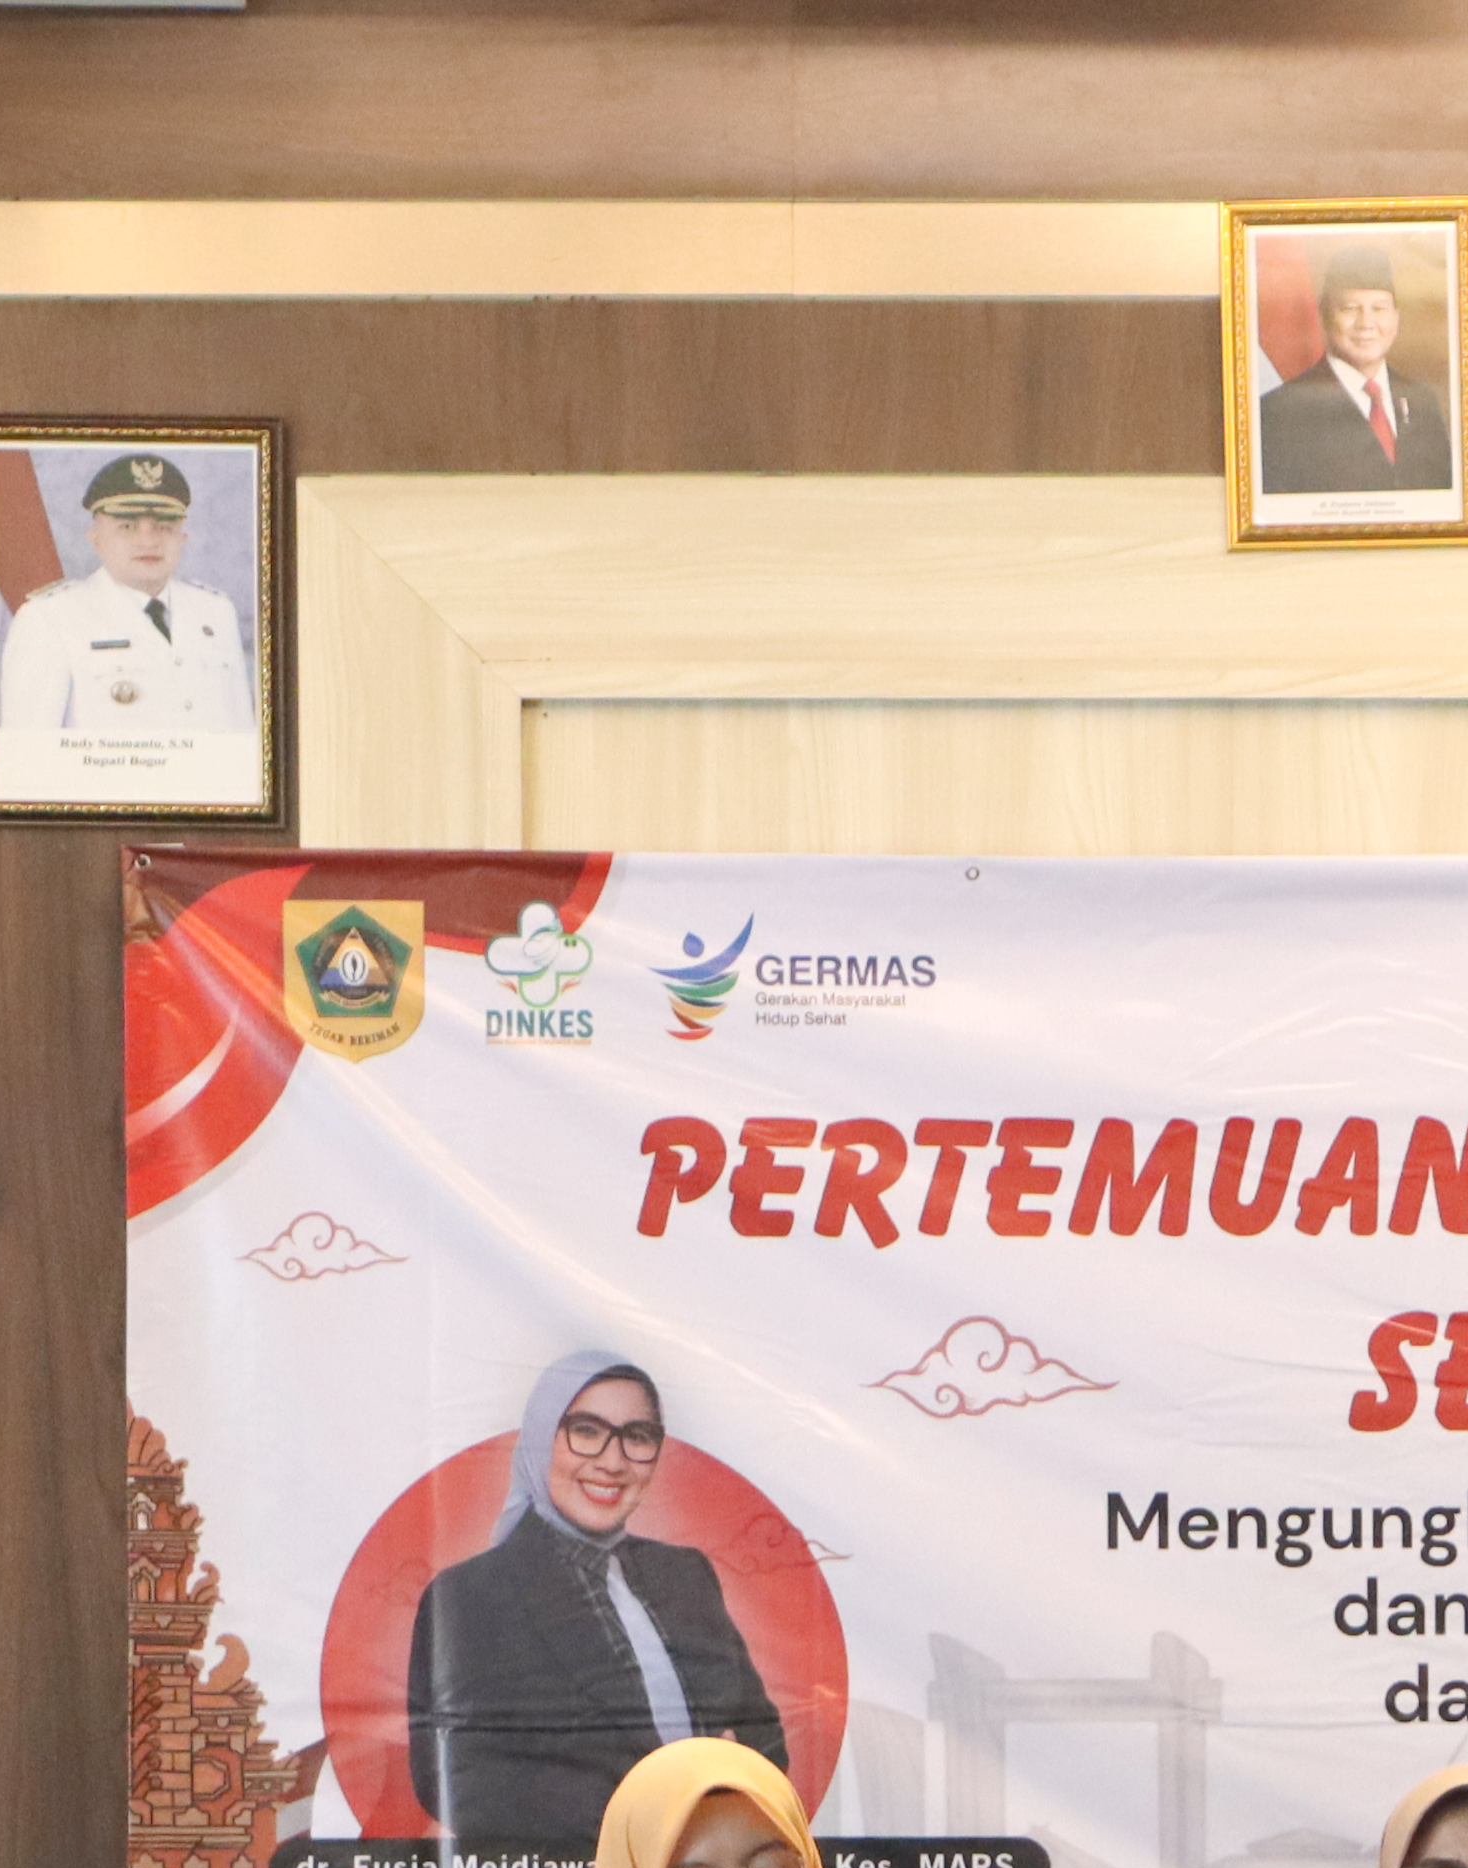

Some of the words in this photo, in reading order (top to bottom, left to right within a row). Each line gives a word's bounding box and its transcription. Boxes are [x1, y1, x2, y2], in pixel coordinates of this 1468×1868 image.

[755, 954, 937, 987] GERMAS
[755, 992, 817, 1006] Gerakan
[823, 993, 906, 1008] Masyarakat
[486, 1009, 594, 1038] DINKES
[755, 1012, 800, 1027] Hidup
[804, 1011, 848, 1026] Sehat
